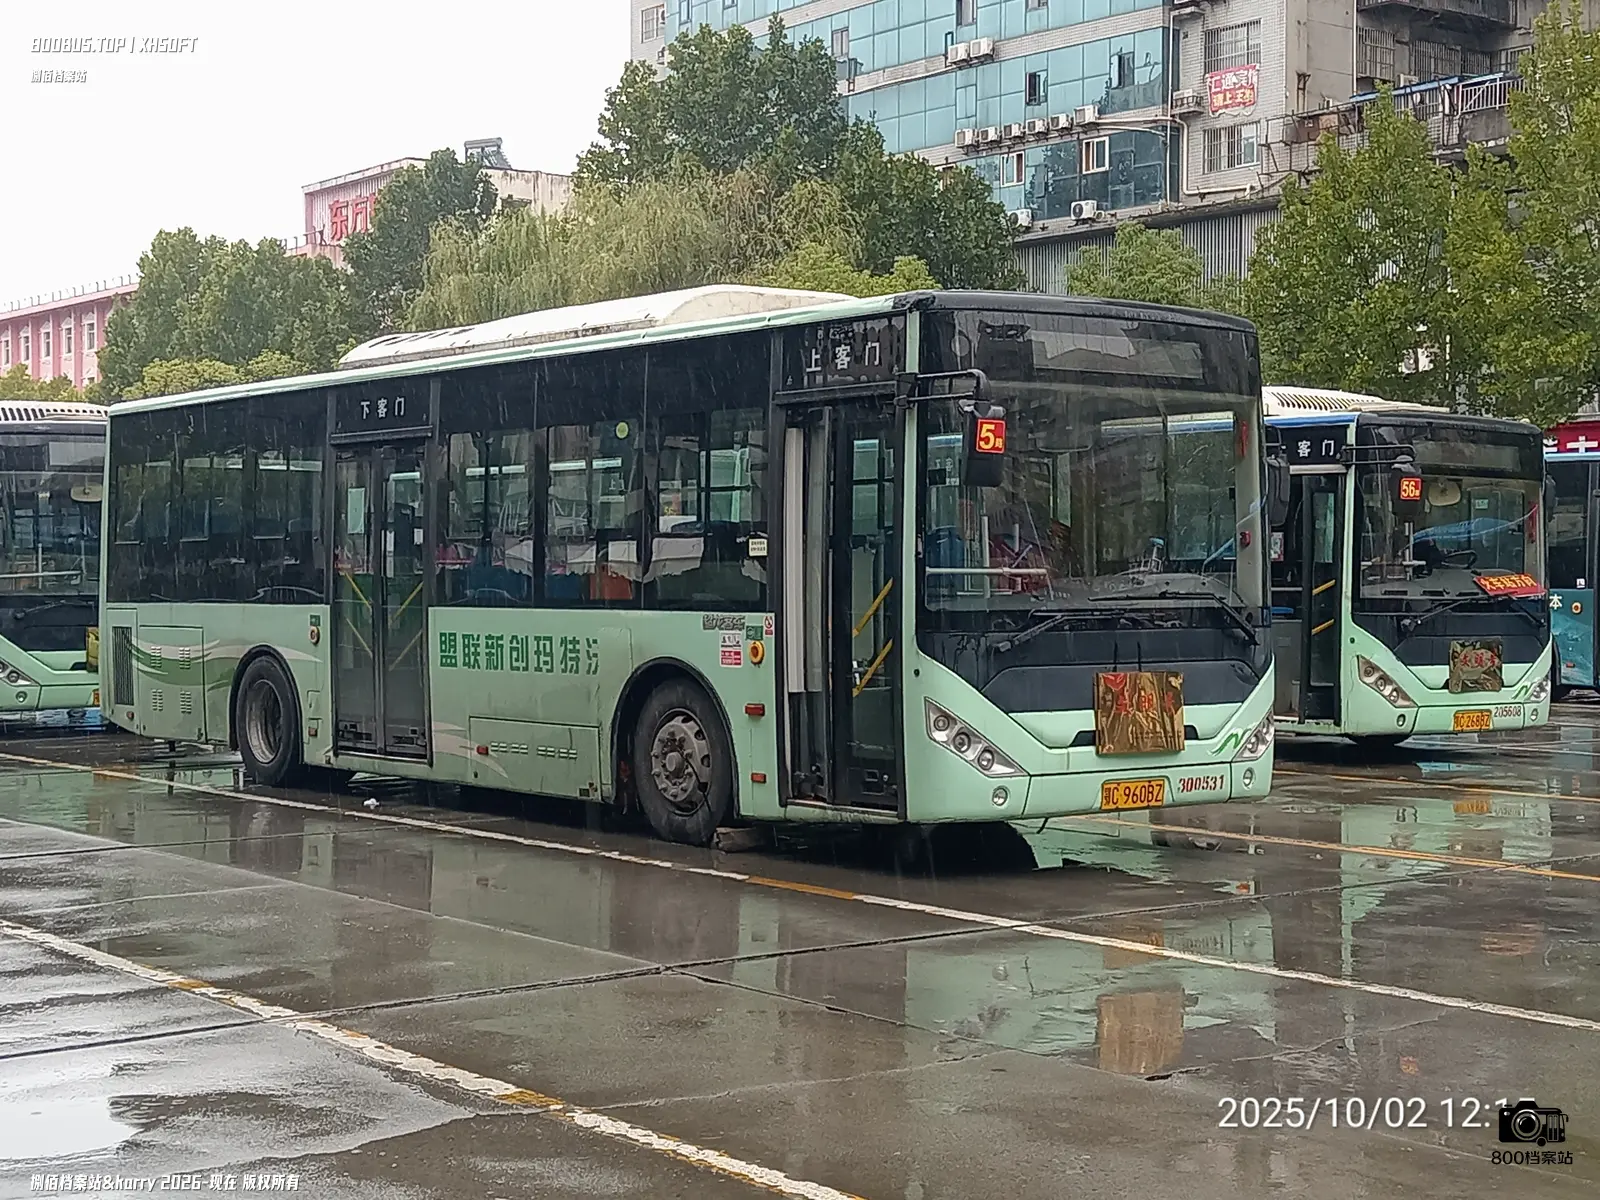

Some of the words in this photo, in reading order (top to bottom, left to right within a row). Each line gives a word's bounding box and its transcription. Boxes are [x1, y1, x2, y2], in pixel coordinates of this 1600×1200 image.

[329, 193, 376, 241] 东方
[806, 341, 881, 373] 上客门
[360, 396, 405, 420] 下客门
[1281, 440, 1335, 457] 客门
[1480, 574, 1538, 591] 火车站方向
[1178, 775, 1225, 793] 300531
